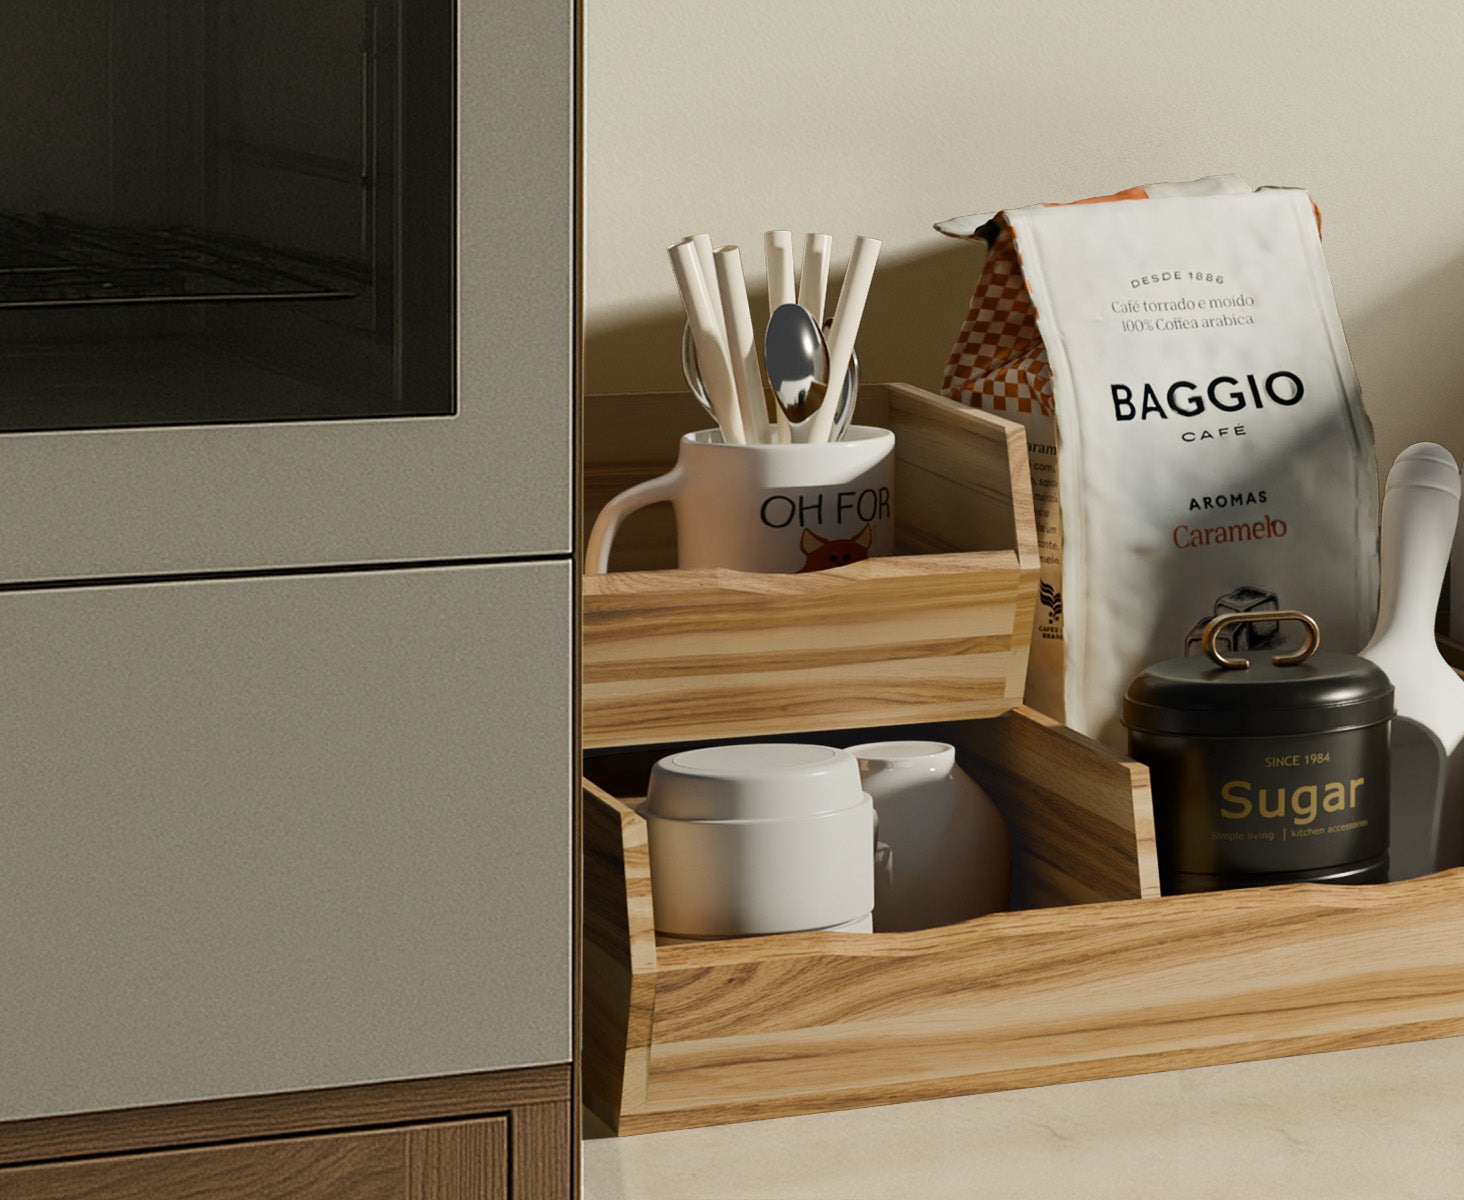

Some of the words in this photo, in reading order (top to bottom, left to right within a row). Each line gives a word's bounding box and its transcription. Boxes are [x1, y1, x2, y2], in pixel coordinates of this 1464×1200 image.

[1130, 271, 1182, 289] DESDE
[1187, 271, 1225, 285] 1886
[1110, 299, 1141, 314] Café
[1143, 297, 1196, 313] torrado
[1198, 299, 1207, 311] e
[1121, 318, 1154, 333] 100%
[1155, 315, 1199, 331] Coffea
[1201, 312, 1255, 329] arabica
[1110, 370, 1305, 421] BAGGIO
[1181, 422, 1247, 442] CAFÉ
[760, 493, 823, 528] OH
[837, 486, 890, 525] FOR
[1188, 490, 1268, 511] AROMAS
[1172, 514, 1288, 550] Caramelo
[1264, 754, 1300, 769] SINCE
[1304, 752, 1331, 766] 1984
[1220, 776, 1365, 825] Sugar
[1291, 826, 1326, 838] kitchen
